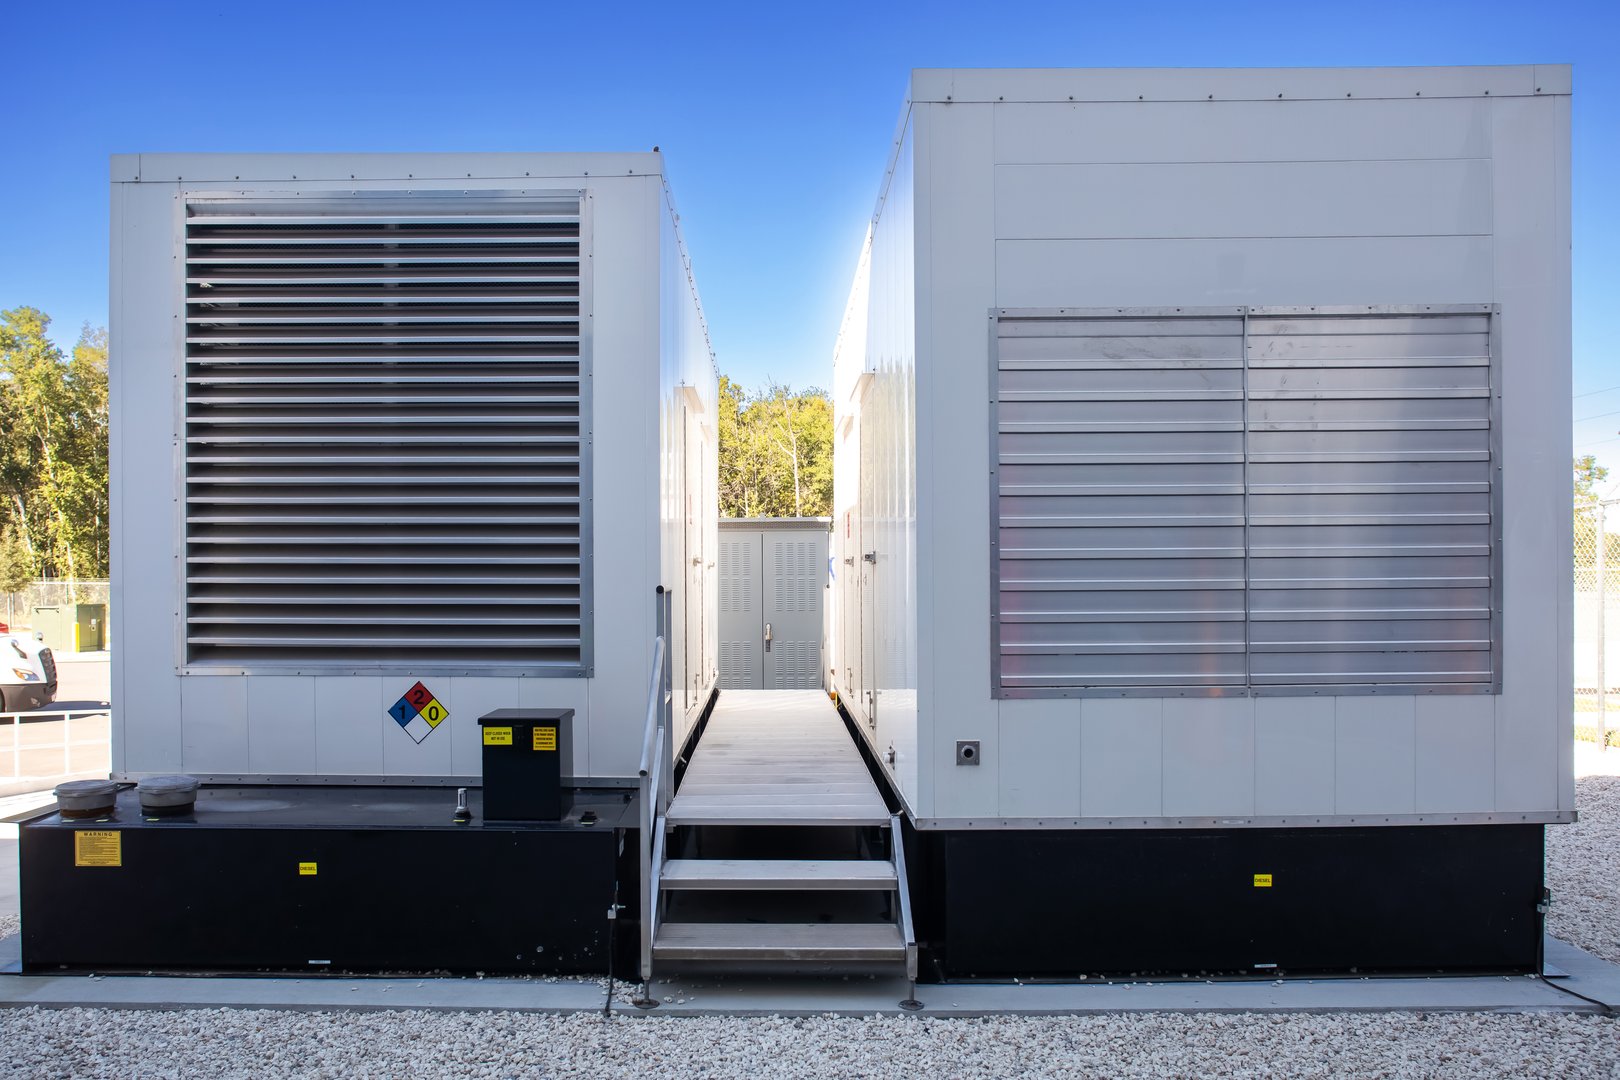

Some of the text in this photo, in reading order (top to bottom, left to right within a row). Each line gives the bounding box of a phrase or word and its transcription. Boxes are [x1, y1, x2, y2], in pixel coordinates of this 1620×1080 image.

[413, 690, 425, 705] 2
[398, 704, 406, 720] 1
[428, 706, 440, 721] 0
